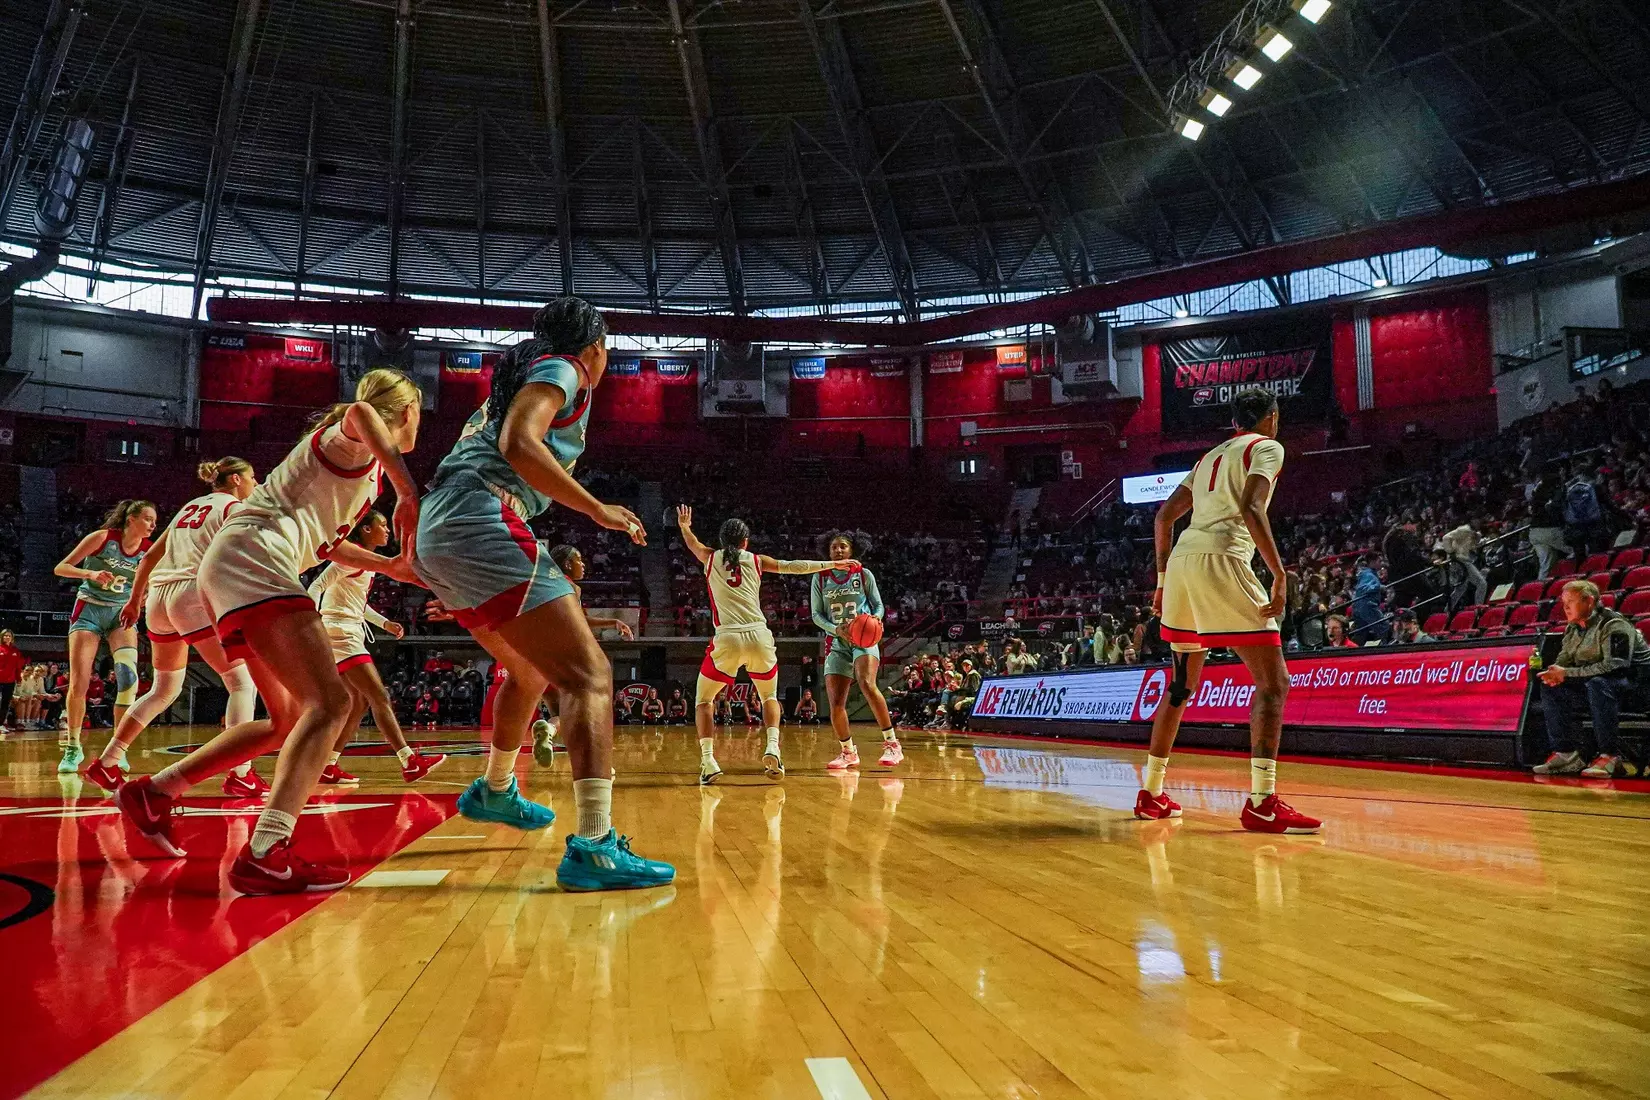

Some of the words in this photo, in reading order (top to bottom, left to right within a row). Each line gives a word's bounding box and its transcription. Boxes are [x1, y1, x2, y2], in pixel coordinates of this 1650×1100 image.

[294, 344, 314, 353] WKU
[1208, 454, 1224, 493] 1
[1140, 484, 1179, 493] CANDLEWOO
[176, 504, 213, 529] 23
[726, 562, 742, 588] 3
[830, 601, 858, 624] 23
[980, 621, 1020, 630] LEACHAN
[1288, 668, 1315, 687] end
[1313, 666, 1338, 688] $50
[1339, 671, 1355, 686] or
[1354, 669, 1392, 686] more
[1393, 663, 1425, 684] and
[1426, 660, 1463, 683] we'll
[1465, 660, 1526, 682] deliver
[628, 687, 644, 695] WKU
[976, 683, 1004, 714] ACE
[999, 686, 1066, 715] REWARDS
[1358, 693, 1388, 714] free.
